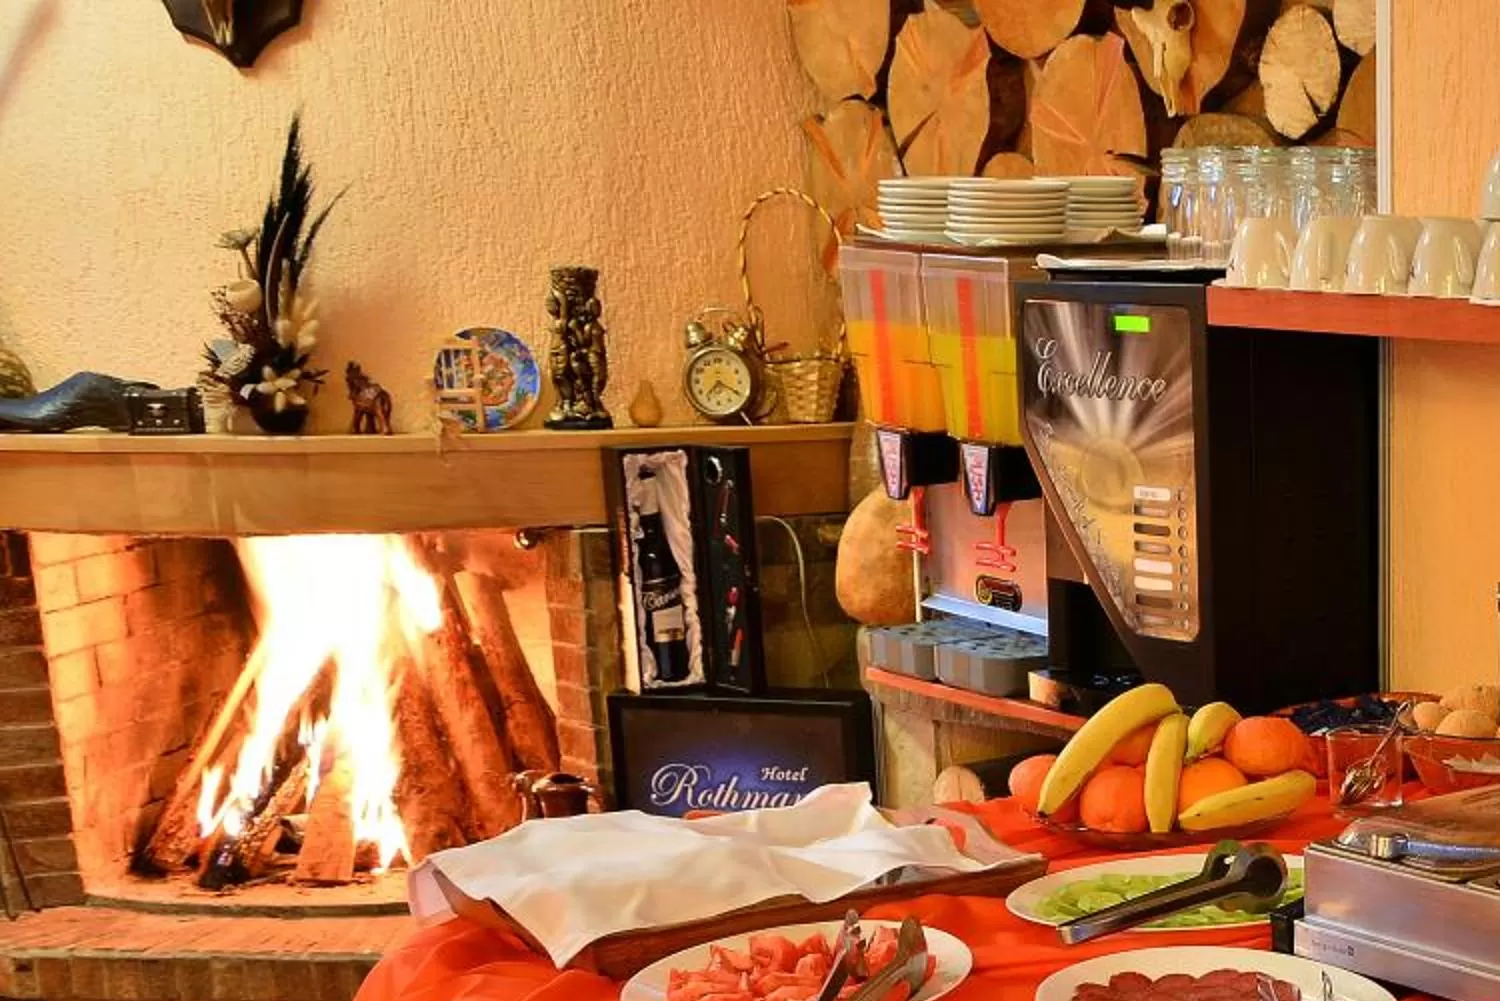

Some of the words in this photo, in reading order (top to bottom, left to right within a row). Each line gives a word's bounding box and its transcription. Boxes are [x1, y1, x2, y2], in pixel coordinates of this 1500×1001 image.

[1035, 337, 1167, 402] Excellence
[651, 763, 801, 808] Rothma
[761, 765, 809, 782] Hotel
